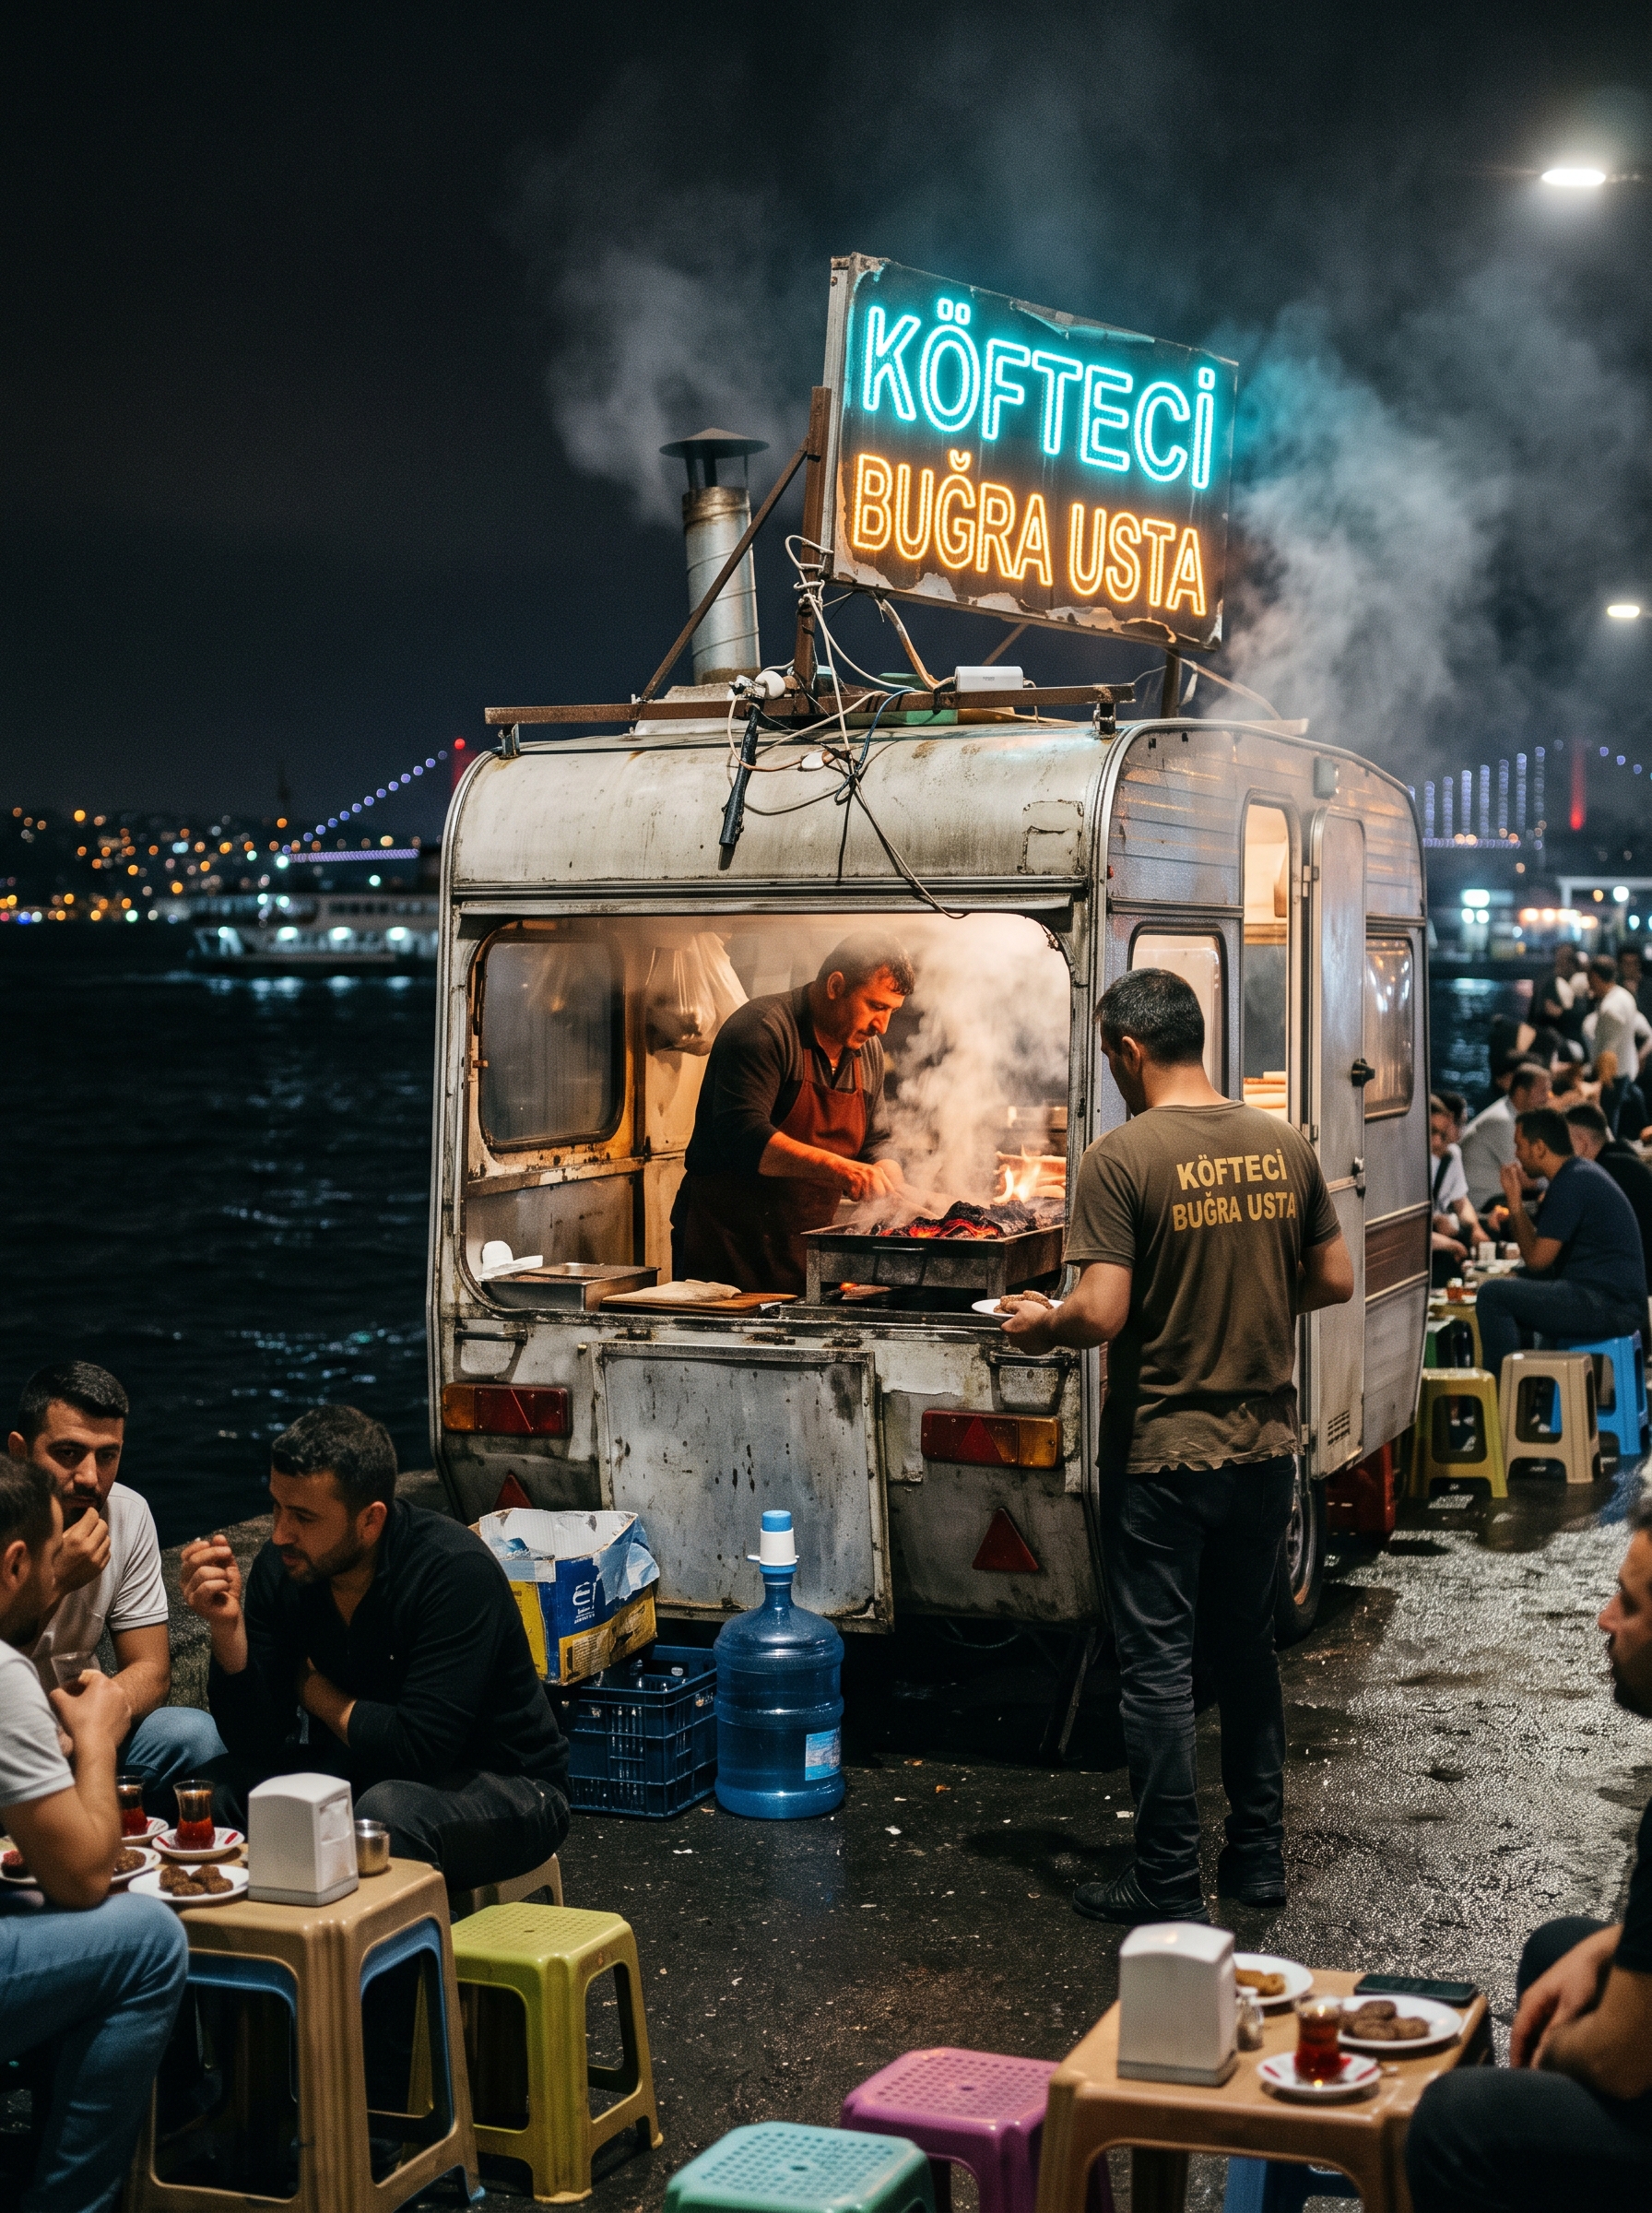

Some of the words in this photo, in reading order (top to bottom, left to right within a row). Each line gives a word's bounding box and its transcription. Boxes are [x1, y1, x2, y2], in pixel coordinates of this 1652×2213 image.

[862, 297, 1215, 490] KÖFTECİ
[853, 449, 1054, 587] BUĞRA
[1069, 503, 1207, 617] USTA
[1173, 1190, 1243, 1231] BUĞRA
[1247, 1191, 1296, 1221] USTA
[1176, 1148, 1288, 1190] KÖFTECİ
